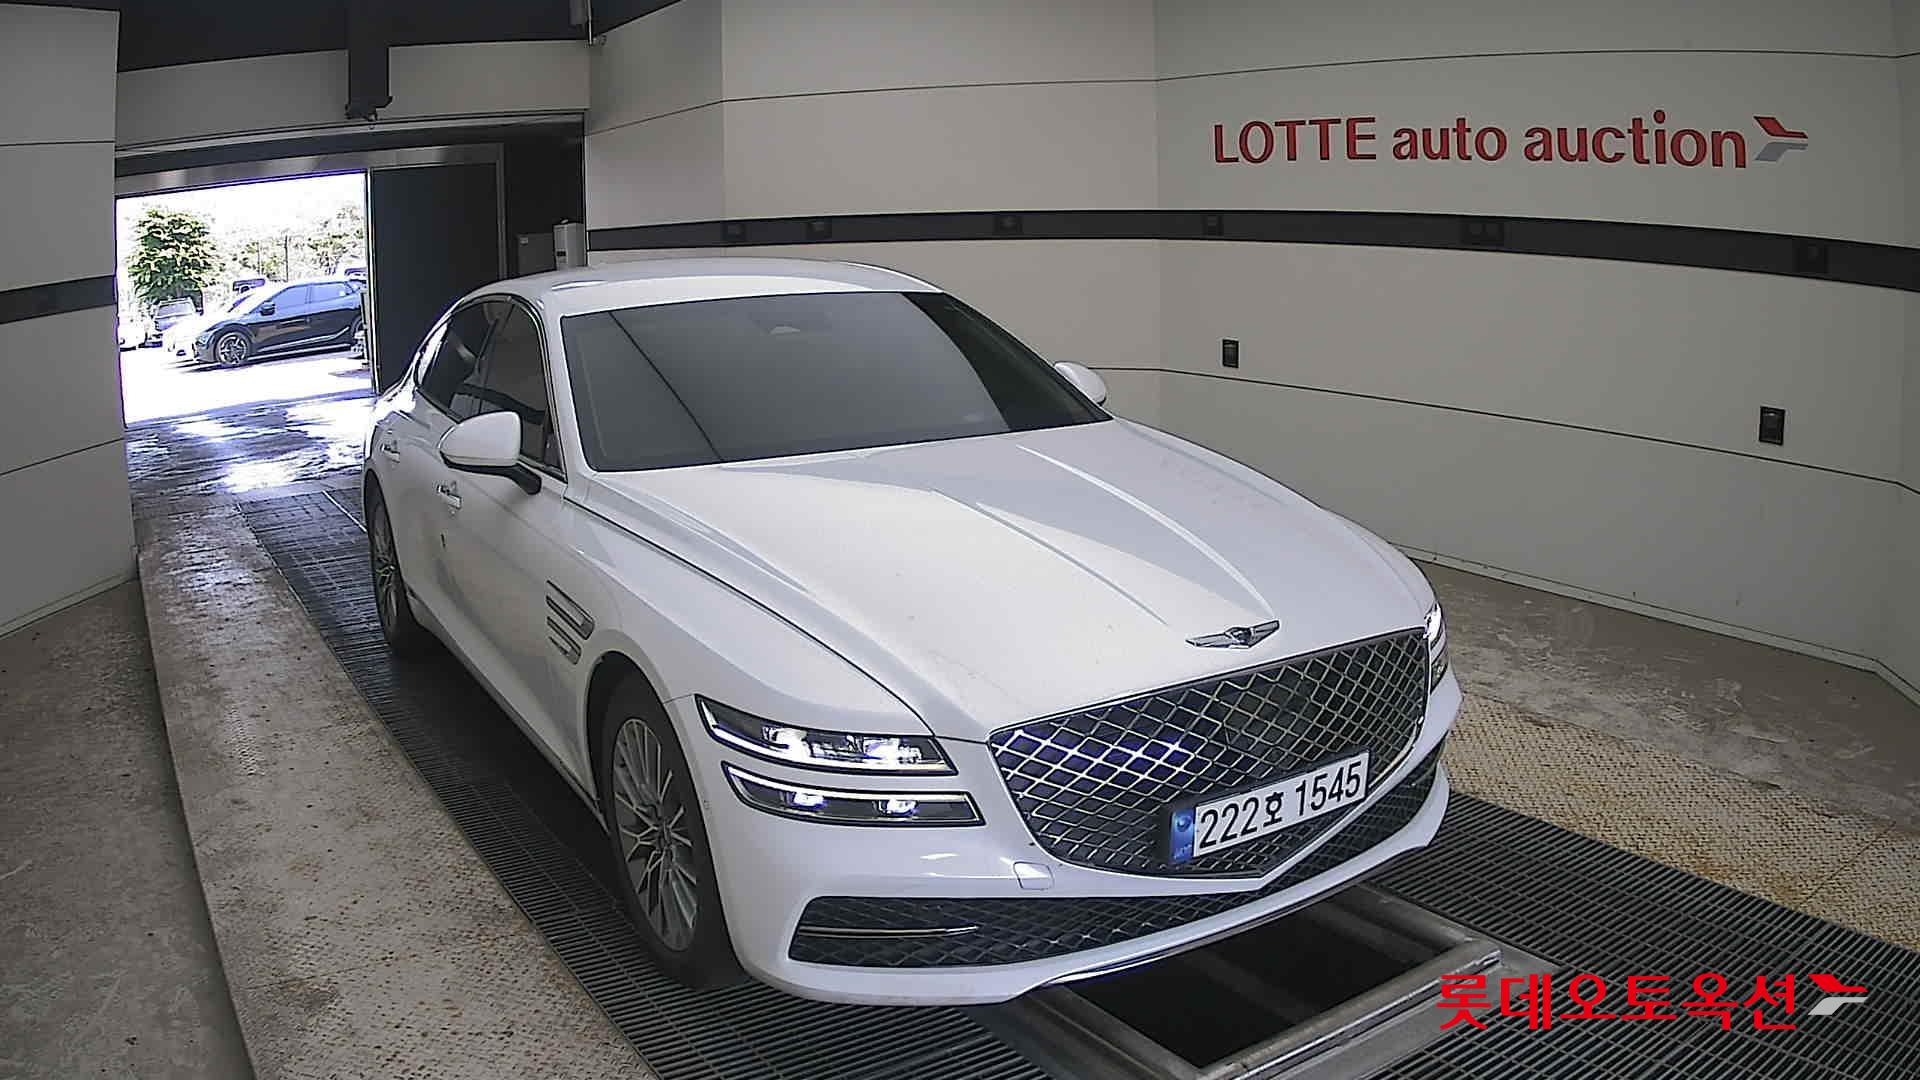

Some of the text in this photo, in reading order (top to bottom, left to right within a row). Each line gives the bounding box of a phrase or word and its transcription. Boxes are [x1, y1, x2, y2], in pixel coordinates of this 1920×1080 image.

[1213, 109, 1747, 169] LOTTE auto auction
[1199, 761, 1362, 849] 222호 1545
